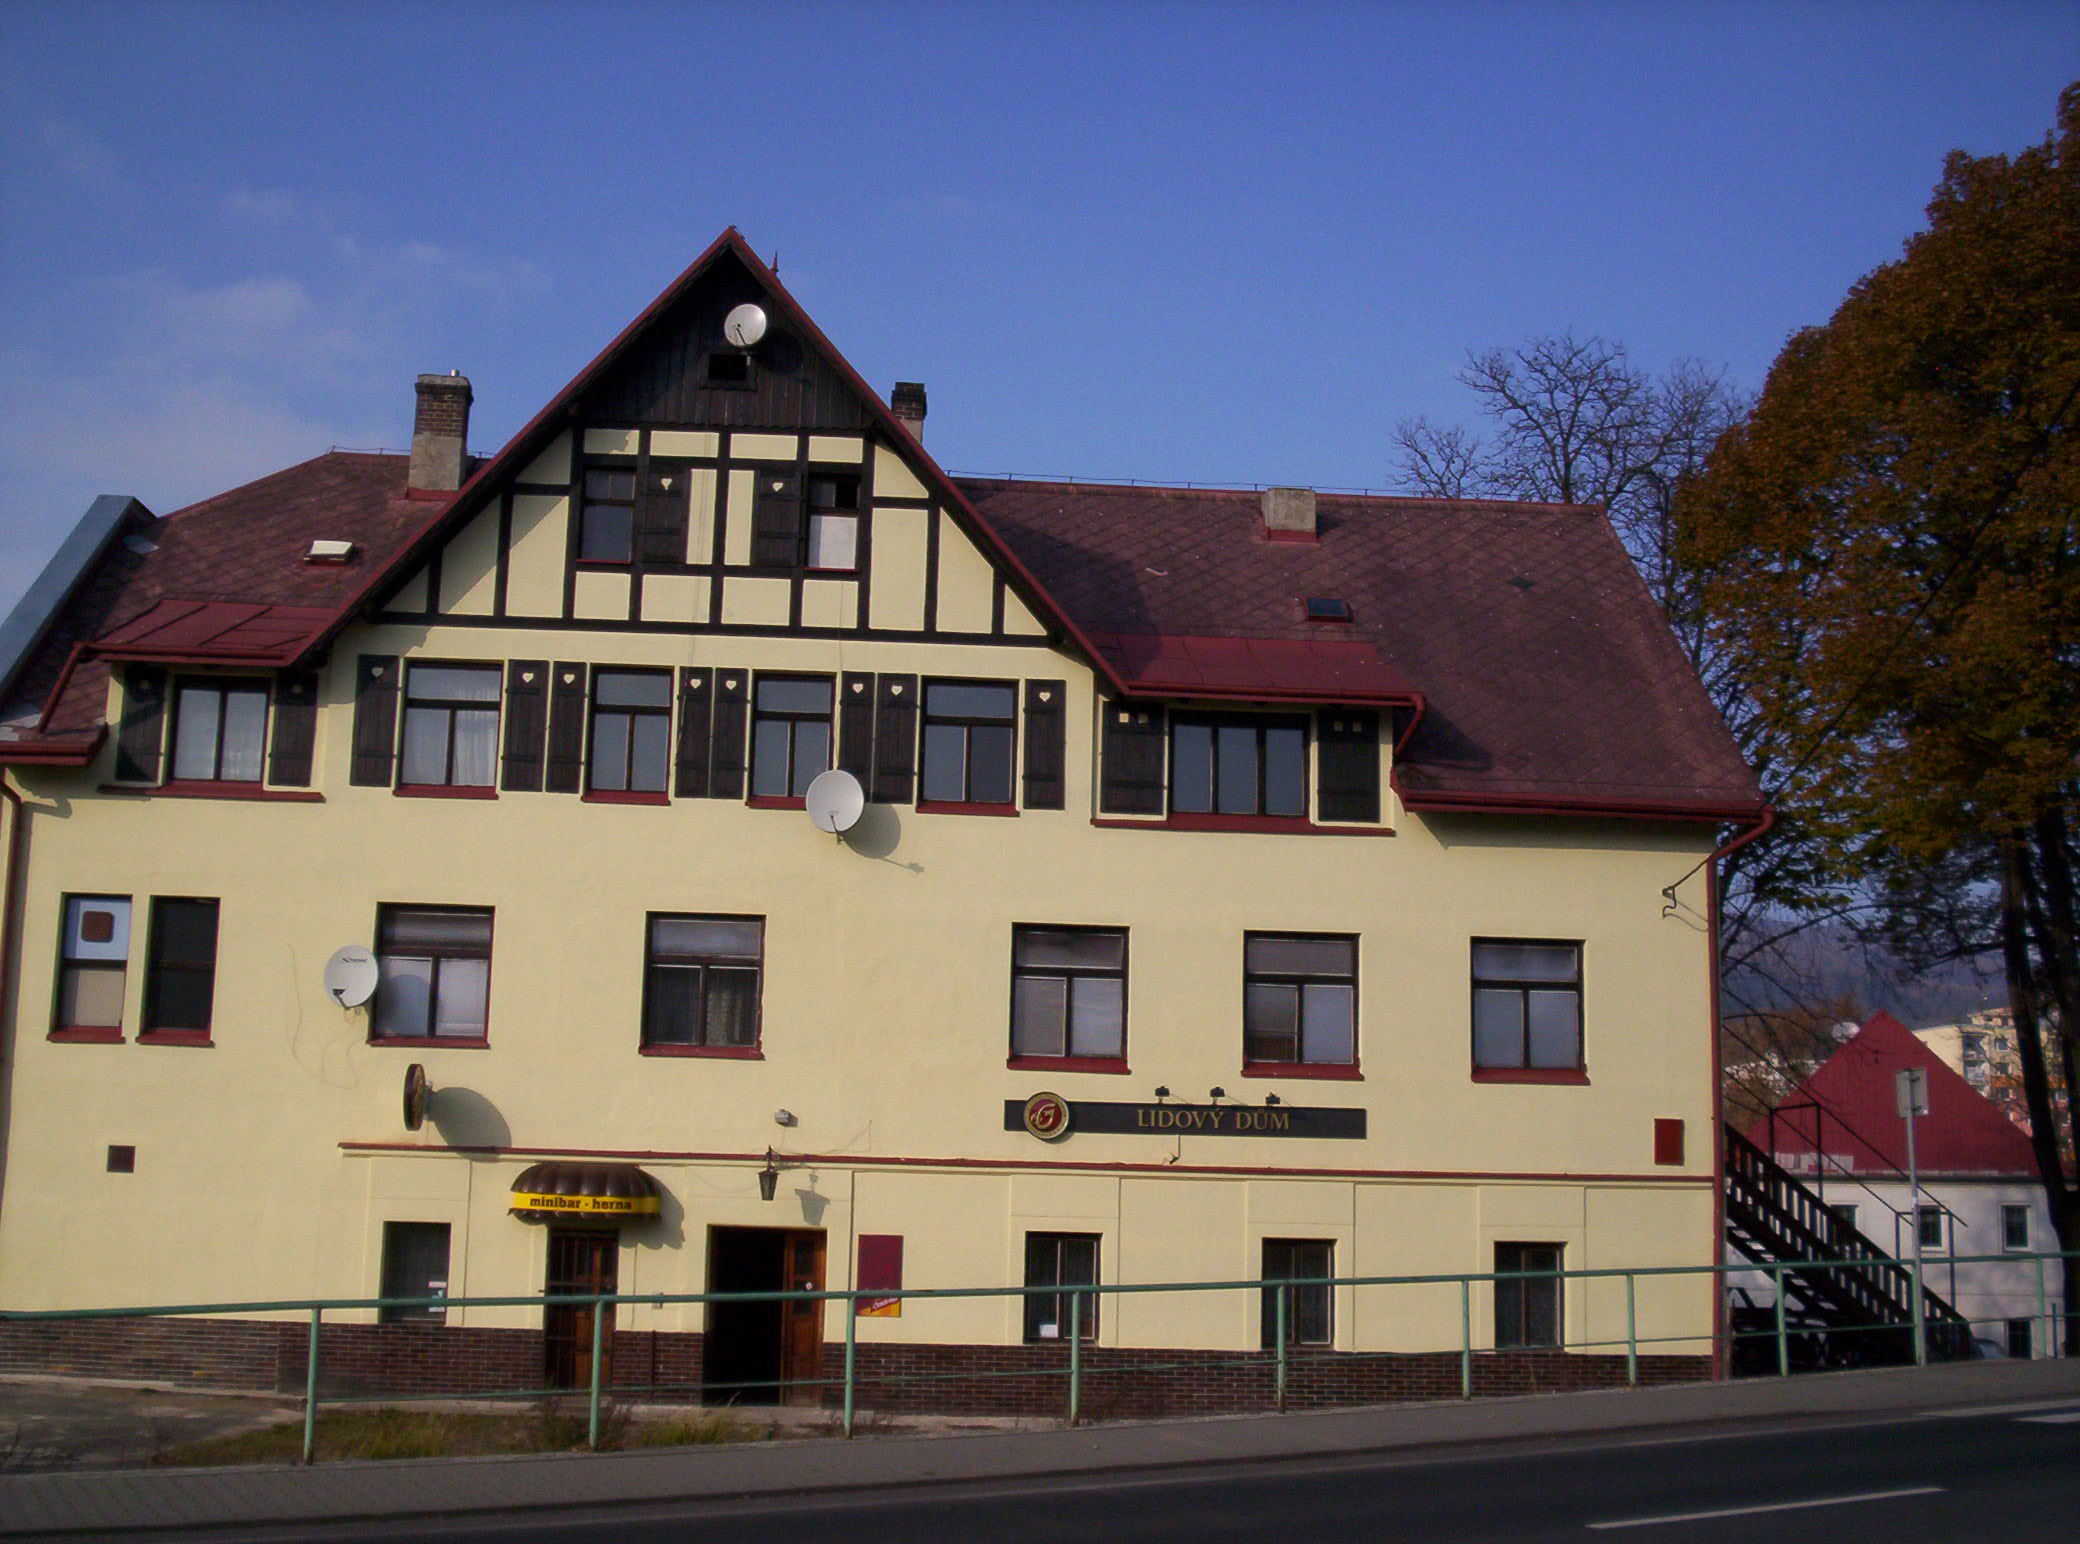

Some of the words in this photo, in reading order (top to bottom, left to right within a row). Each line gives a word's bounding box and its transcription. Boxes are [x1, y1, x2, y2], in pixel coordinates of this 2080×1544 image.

[1137, 1107, 1224, 1129] LIDOVÝ
[1236, 1108, 1290, 1130] DŮM
[529, 1196, 581, 1208] minibar
[592, 1198, 632, 1210] herna
